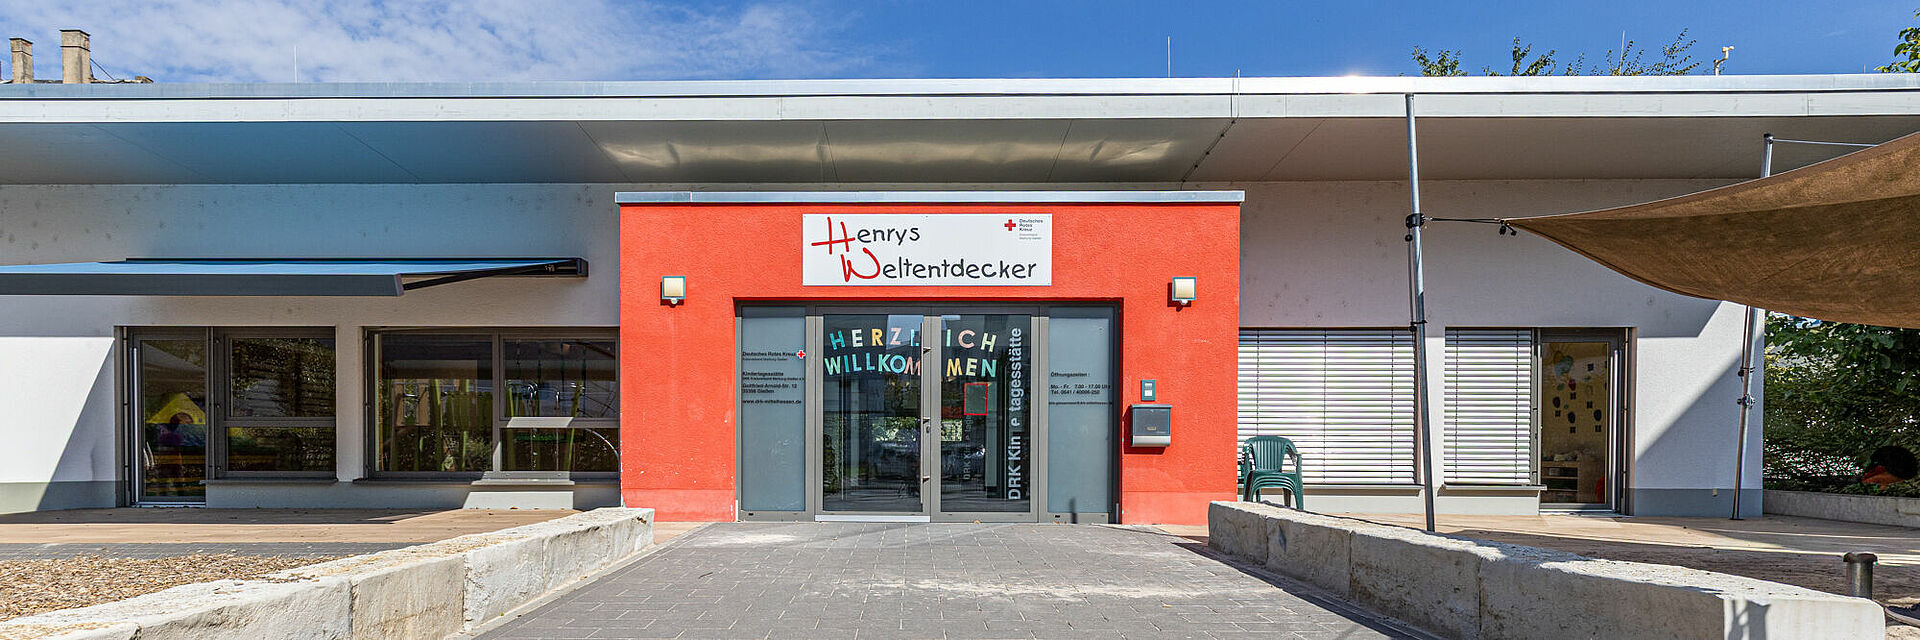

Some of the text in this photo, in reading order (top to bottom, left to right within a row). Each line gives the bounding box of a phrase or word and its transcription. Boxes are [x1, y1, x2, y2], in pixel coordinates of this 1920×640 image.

[811, 216, 920, 254] Henrys
[840, 247, 1037, 282] Weltentdecker
[1008, 468, 1022, 500] DRK
